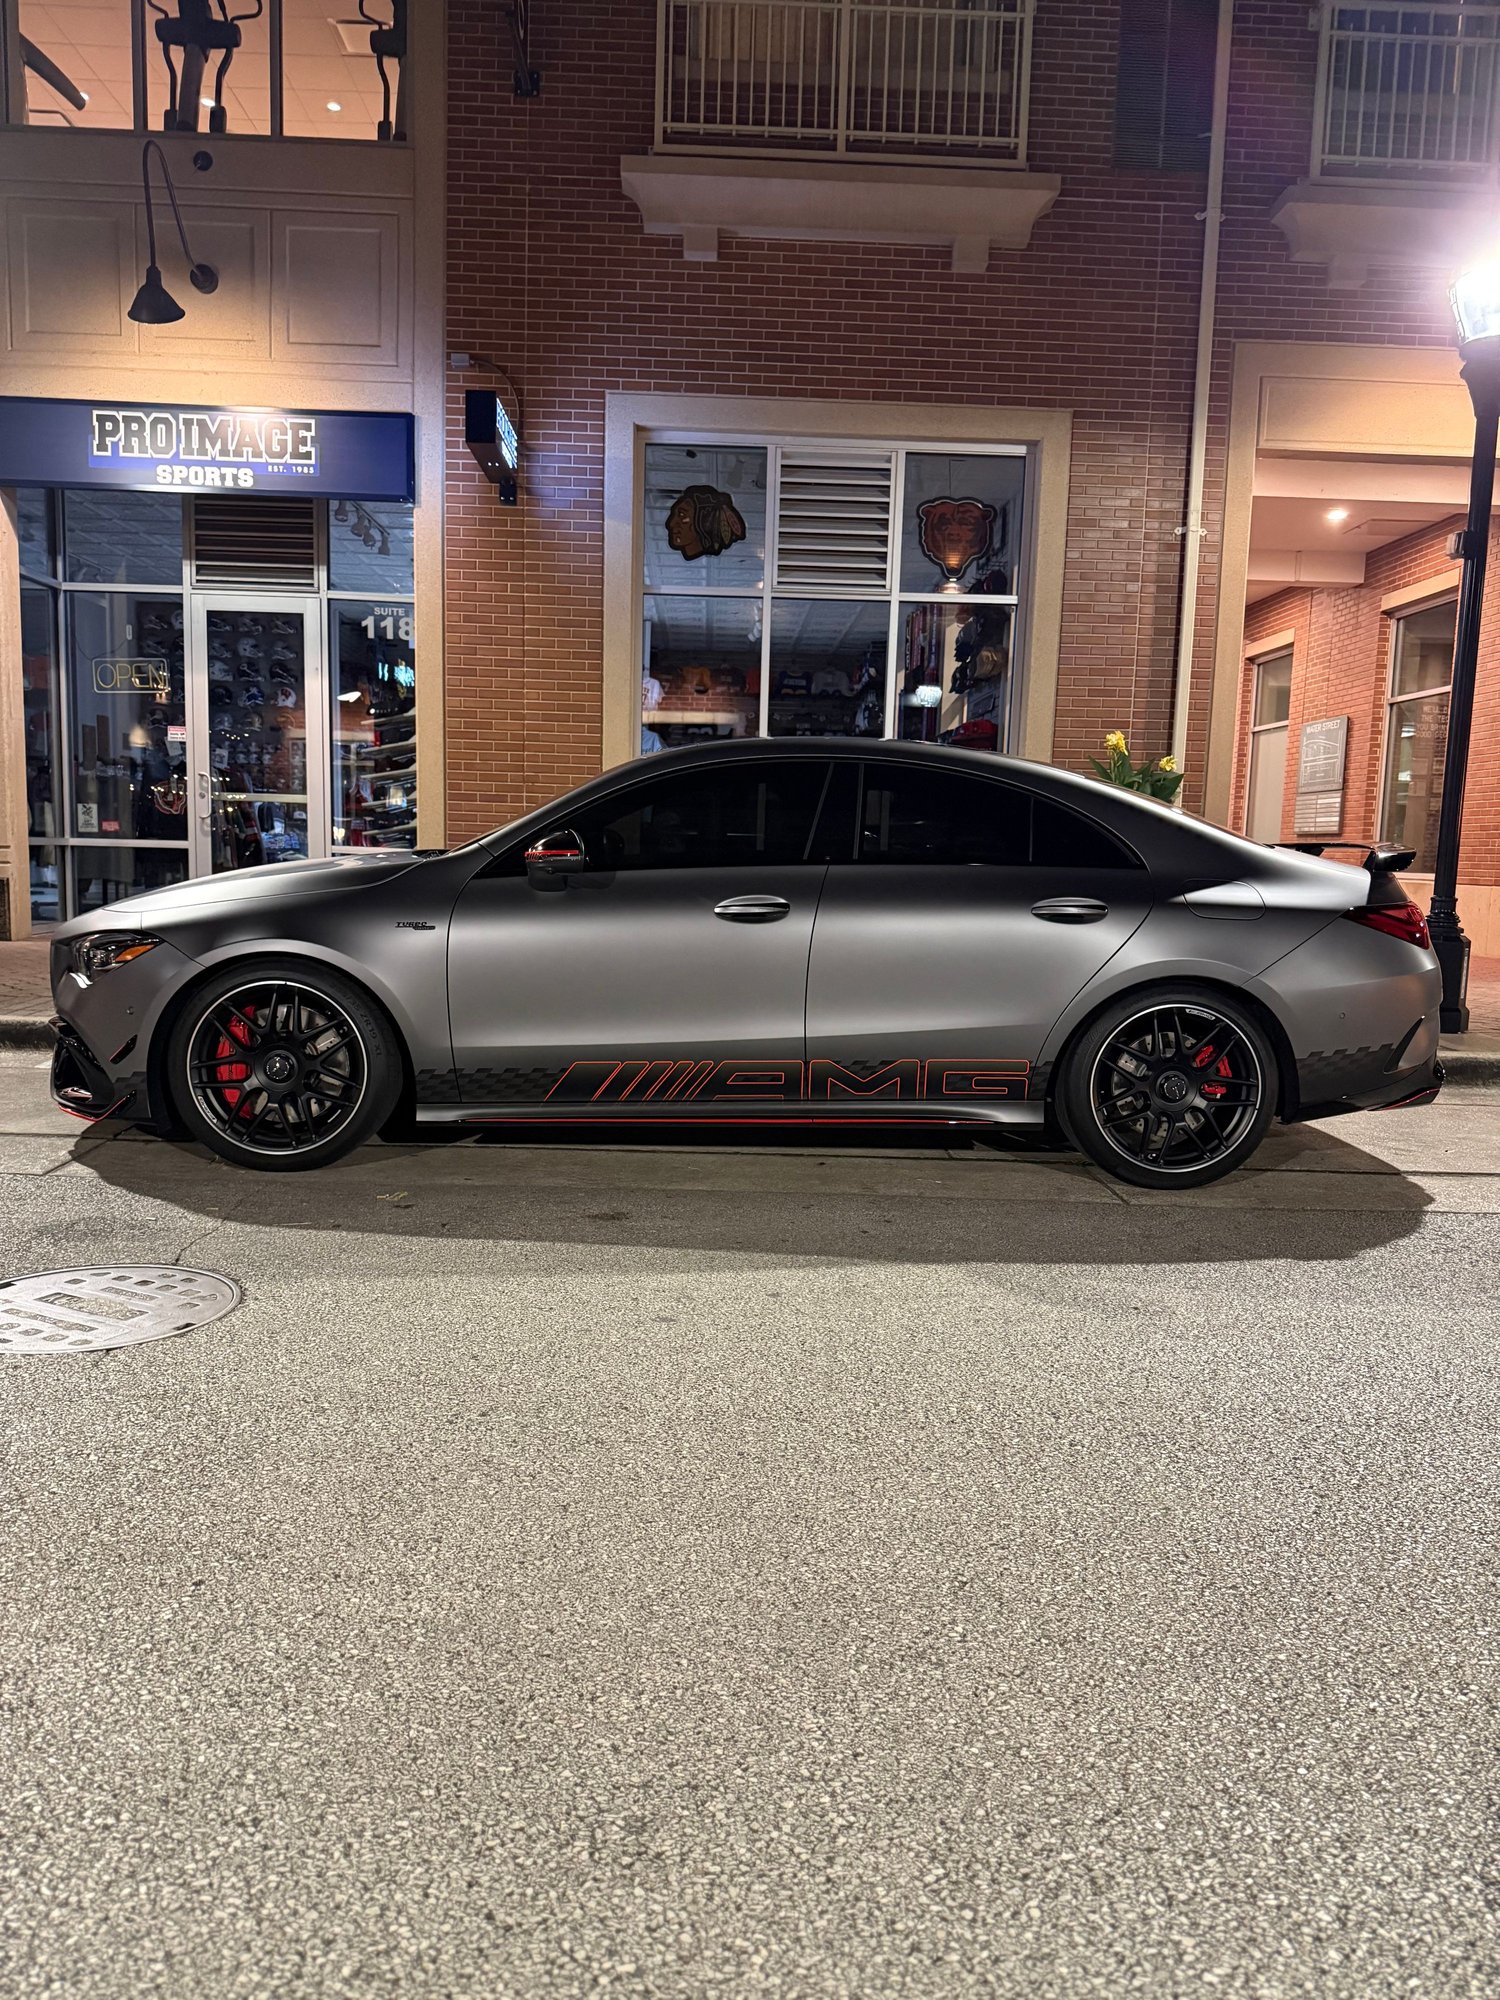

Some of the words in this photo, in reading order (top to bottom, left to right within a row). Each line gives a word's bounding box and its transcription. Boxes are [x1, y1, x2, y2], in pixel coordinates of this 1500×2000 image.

[92, 410, 176, 459] PRO
[179, 414, 315, 464] IMAGE
[156, 464, 254, 487] SPORTS
[268, 465, 287, 473] EST.
[292, 466, 314, 474] 1985
[374, 607, 405, 616] SUITE
[361, 615, 415, 641] 118
[97, 663, 164, 688] OPEN
[1322, 719, 1341, 731] STREET
[691, 1058, 1030, 1101] AMG
